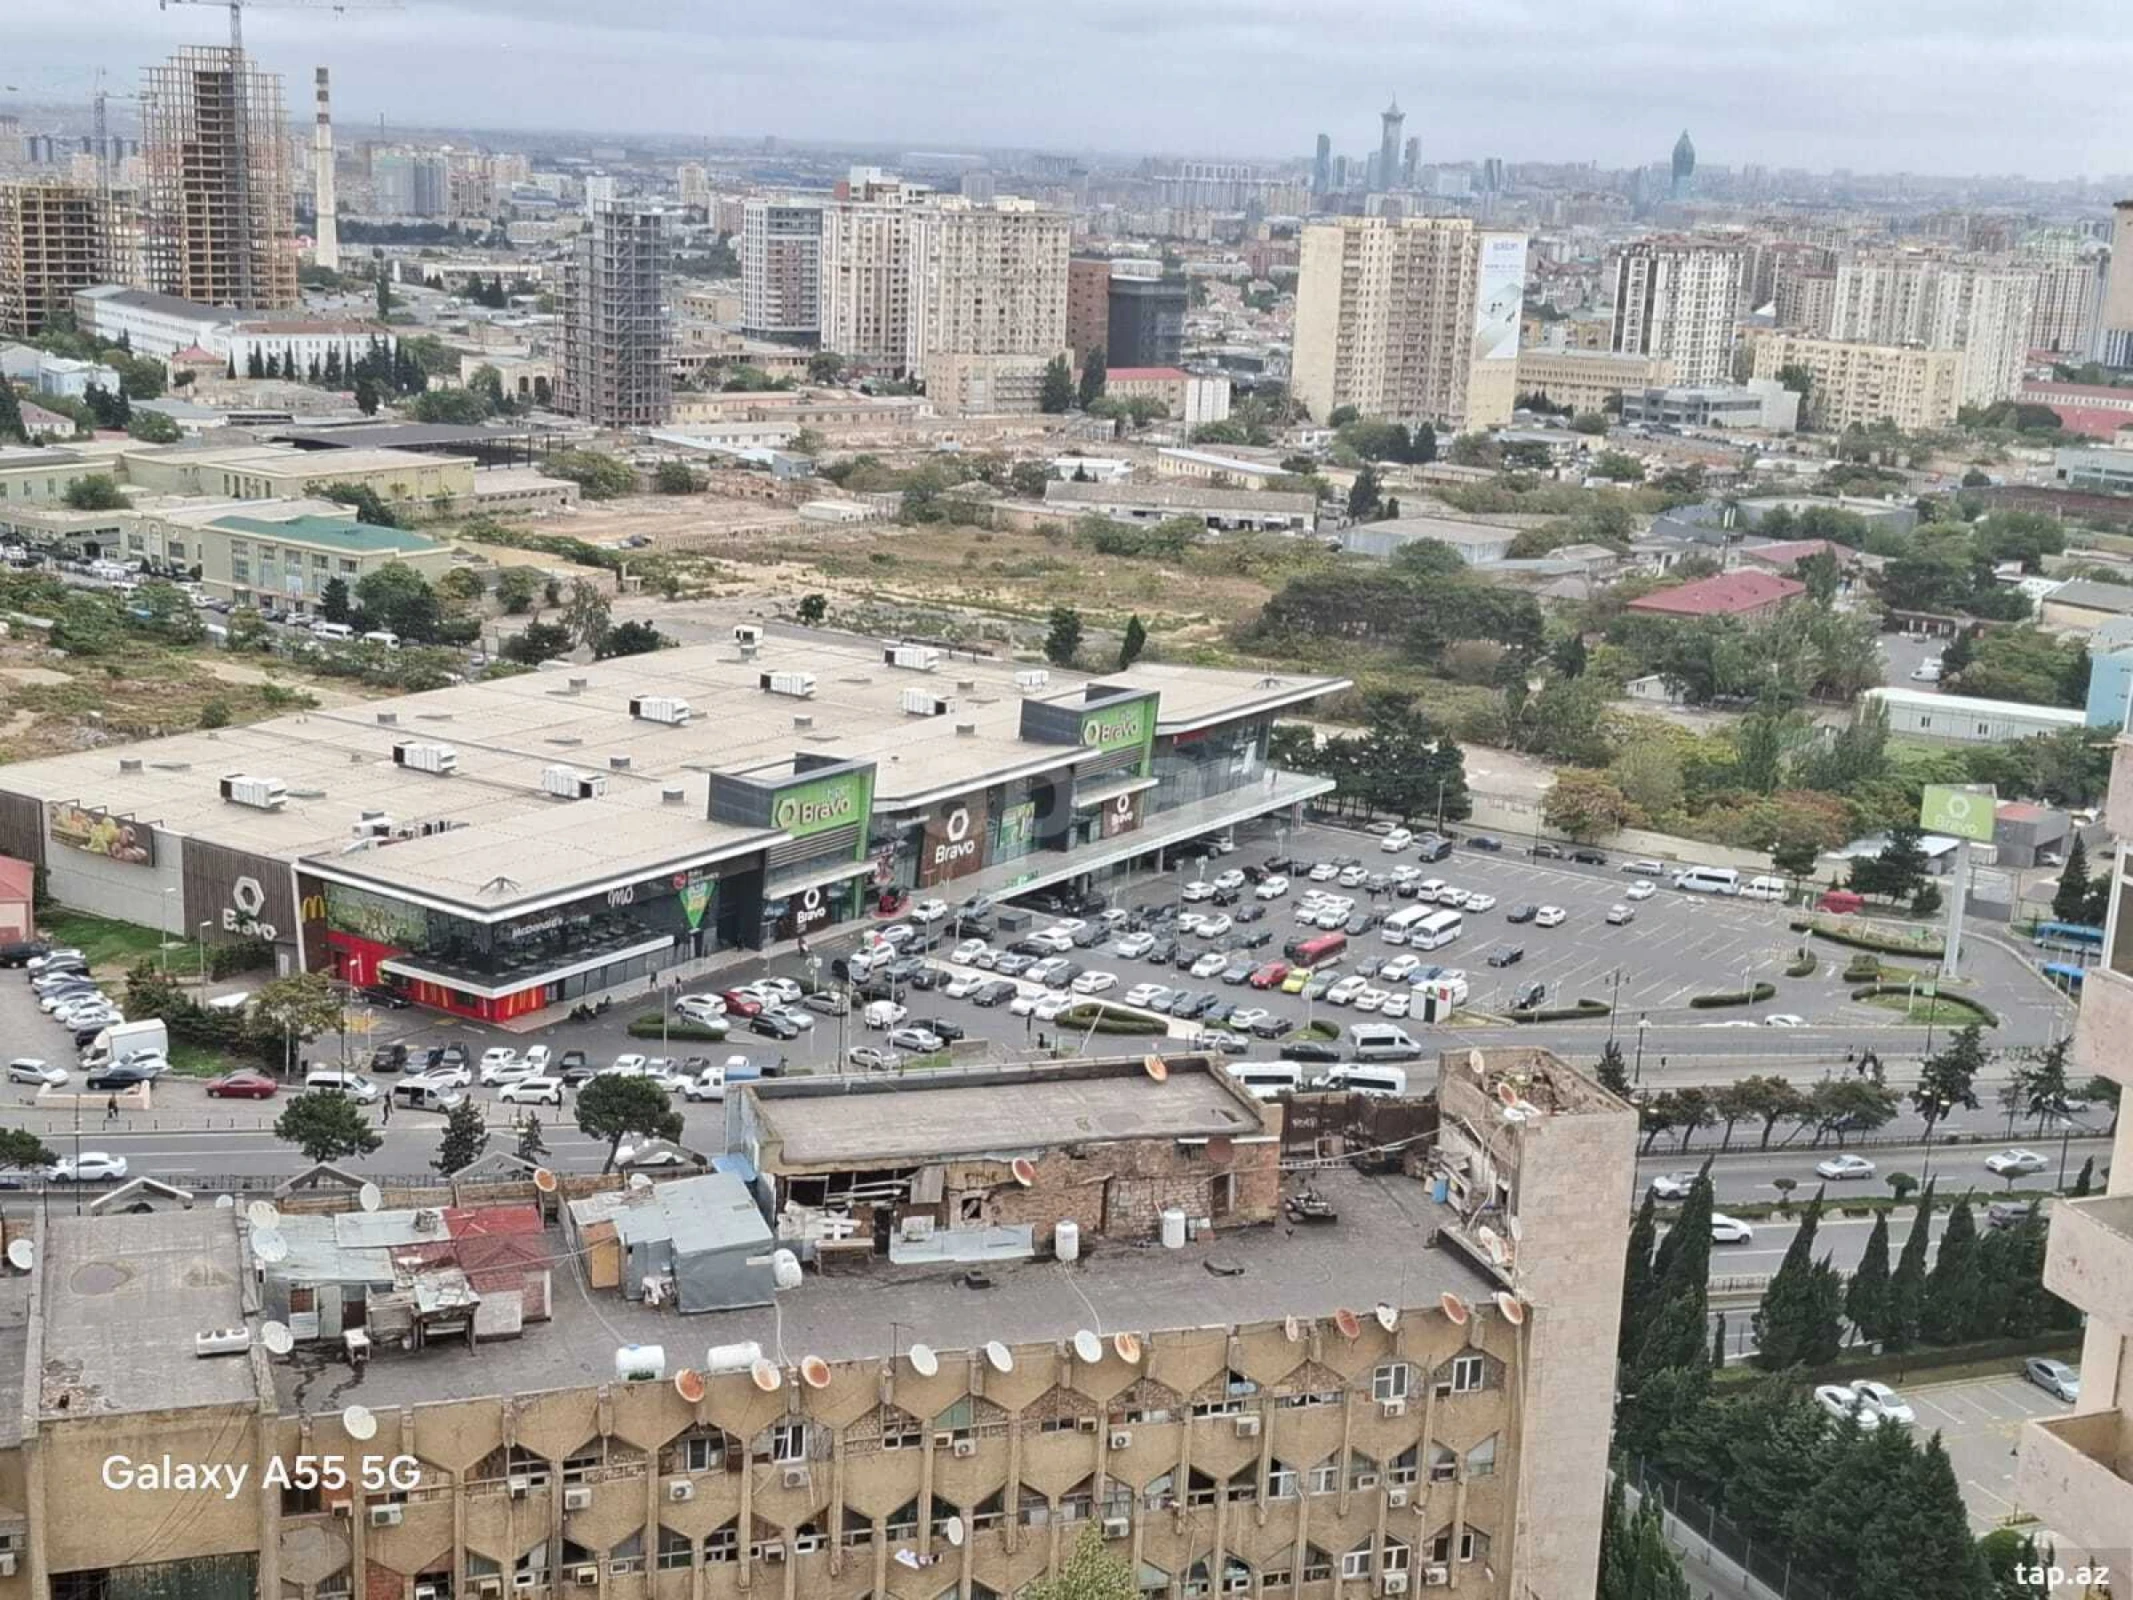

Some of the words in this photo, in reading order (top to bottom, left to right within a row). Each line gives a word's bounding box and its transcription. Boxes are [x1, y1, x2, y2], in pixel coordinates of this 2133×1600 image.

[1101, 720, 1138, 742] Bravo
[800, 798, 850, 824] Bravo
[1934, 814, 1978, 834] Bravo
[935, 840, 975, 864] Bravo
[796, 906, 827, 924] Bravo
